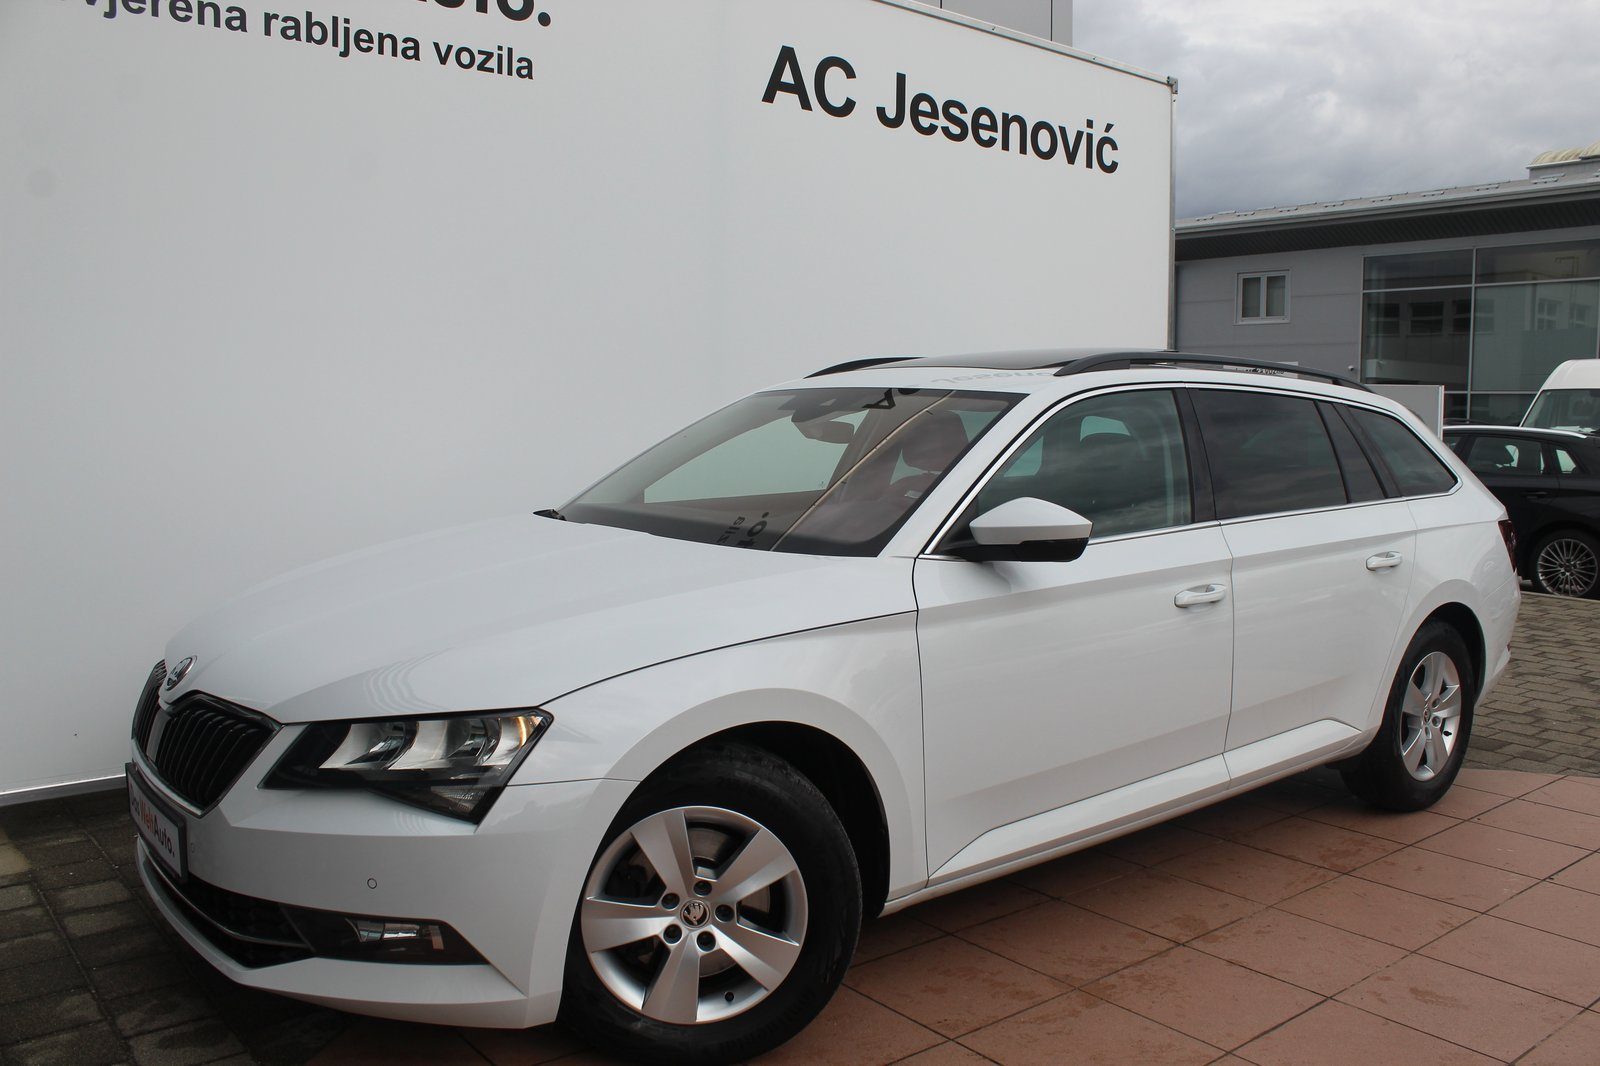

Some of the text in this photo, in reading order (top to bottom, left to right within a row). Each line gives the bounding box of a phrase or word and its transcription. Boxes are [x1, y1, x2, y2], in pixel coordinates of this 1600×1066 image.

[263, 11, 421, 62] rabljena
[432, 44, 534, 81] vozila
[761, 45, 1119, 174] AC Jesenović
